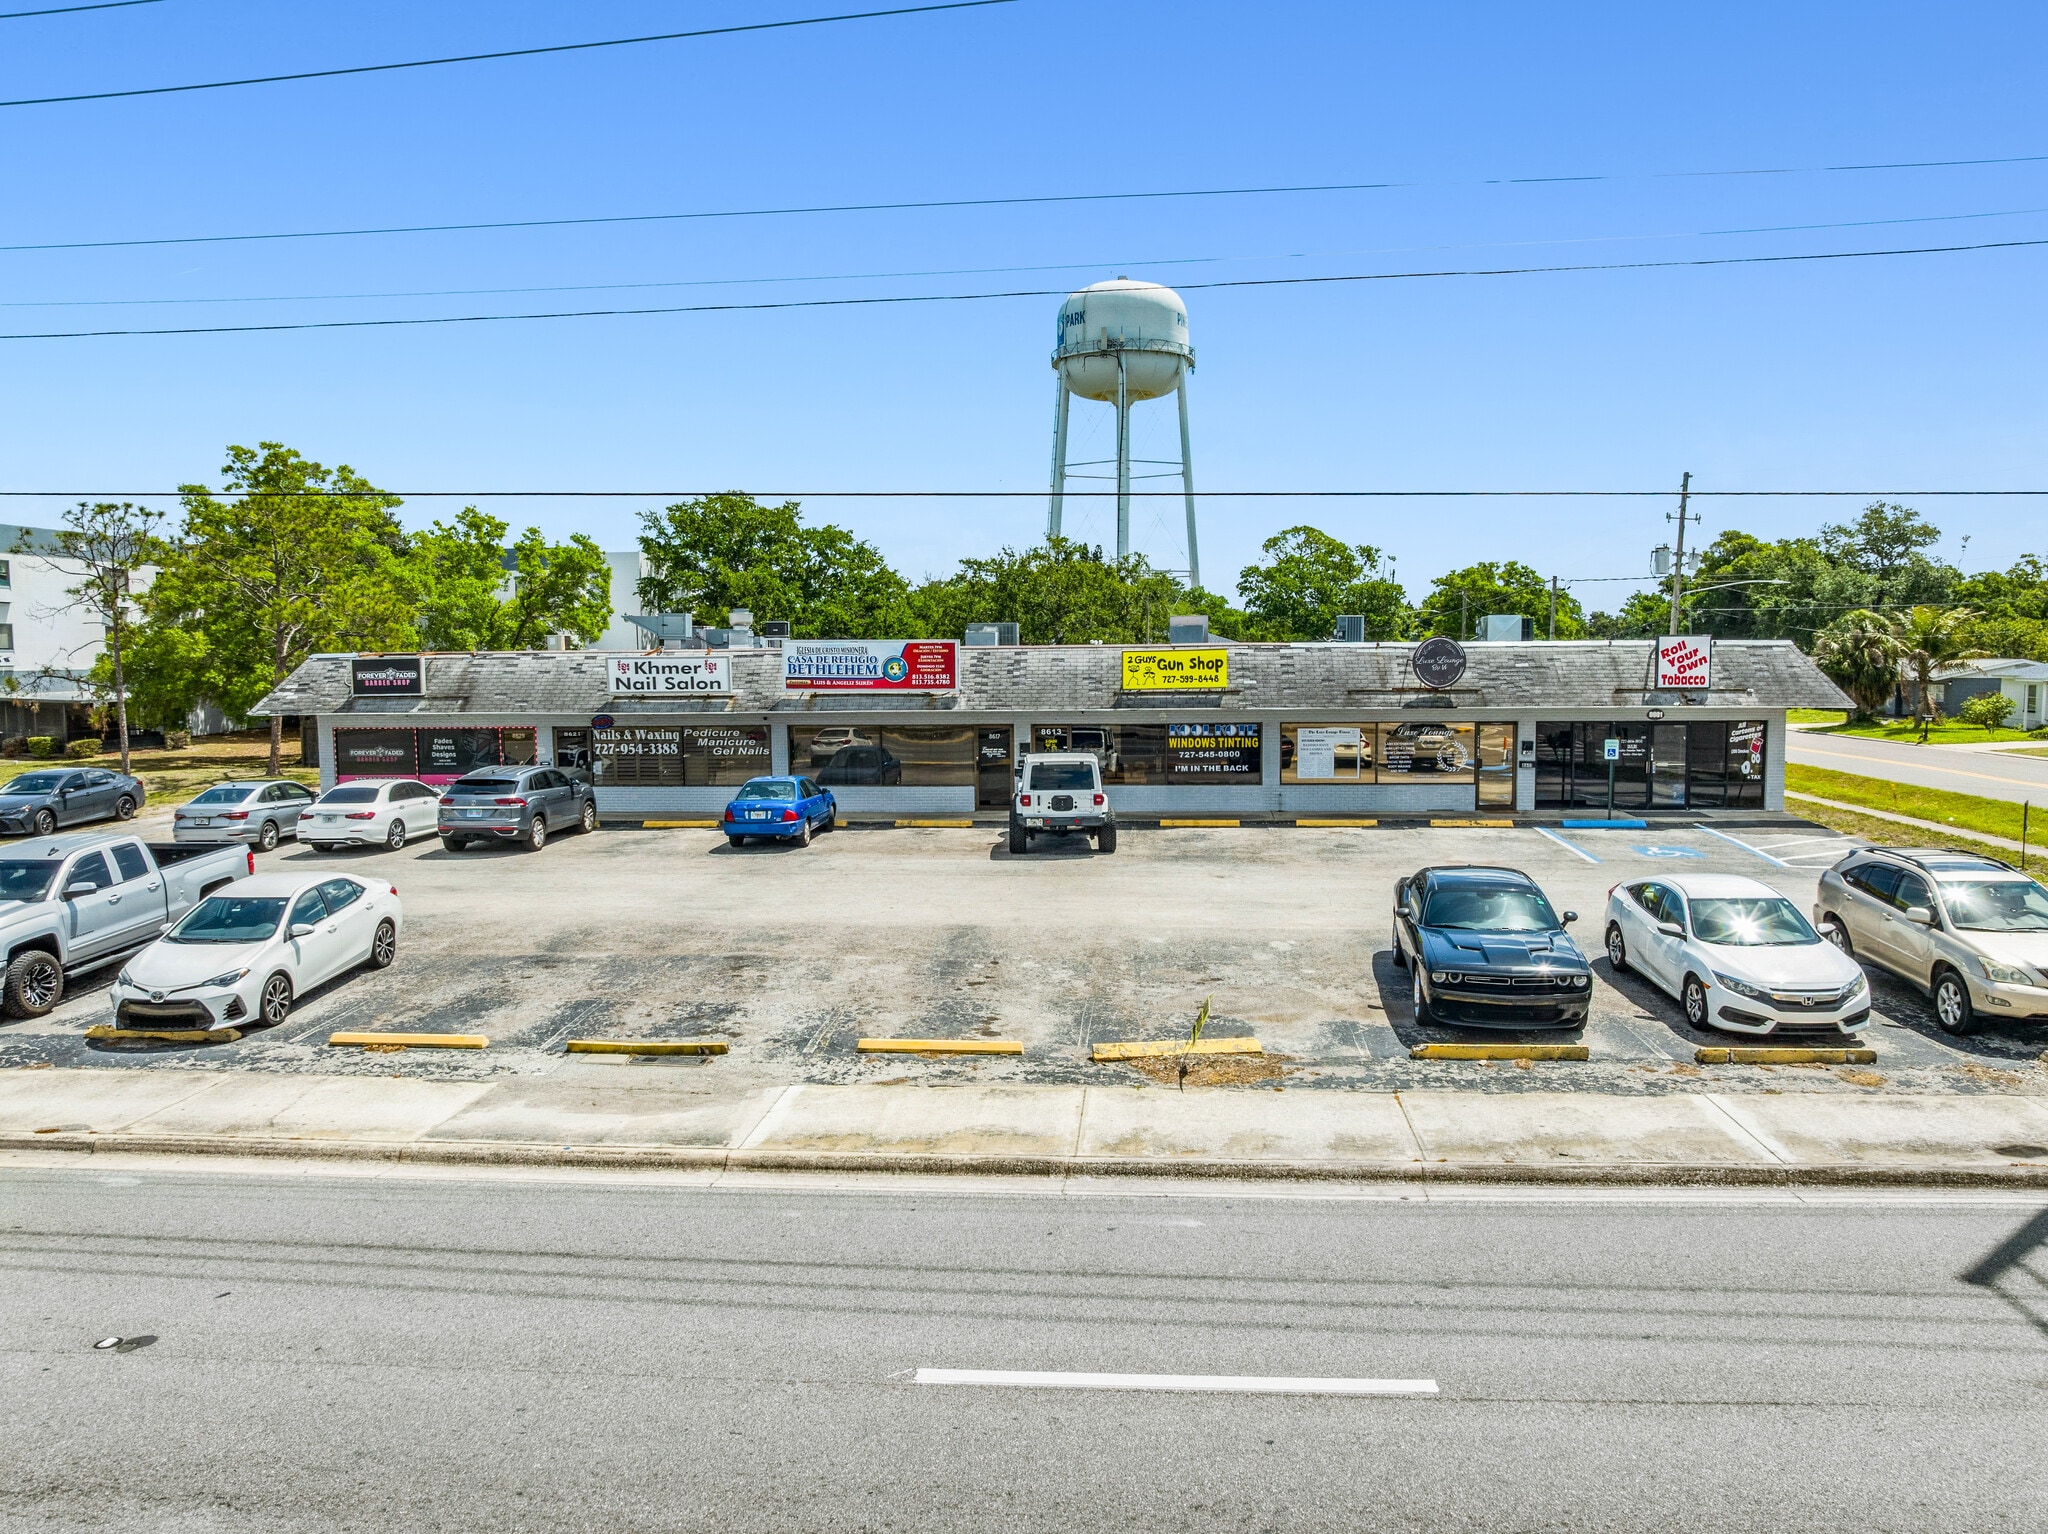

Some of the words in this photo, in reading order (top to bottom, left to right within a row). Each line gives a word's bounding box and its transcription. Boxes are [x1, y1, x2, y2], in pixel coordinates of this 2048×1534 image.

[1066, 310, 1086, 328] PARK
[1660, 640, 1687, 659] Roll
[787, 655, 815, 664] CASA
[816, 655, 830, 664] DE
[831, 655, 878, 664] REFUGIO
[1127, 656, 1133, 664] 2
[1134, 656, 1157, 664] GUYS
[1157, 658, 1184, 671] Gun
[1189, 656, 1224, 673] Shop
[1677, 656, 1708, 674] Own
[634, 661, 702, 674] Khmer
[787, 664, 878, 675] BETHLEHEM
[395, 671, 417, 679] FADED
[1162, 675, 1219, 683] 727-599-8448
[1661, 674, 1706, 685] Tobacco
[615, 676, 658, 690] Nail
[665, 676, 722, 690] Salon
[593, 729, 621, 740] Nails
[623, 730, 632, 740] &
[634, 729, 680, 742] Waxing
[683, 728, 740, 737] Pedicure
[1421, 726, 1455, 738] Lounge
[1731, 727, 1756, 736] Cartons
[697, 738, 757, 746] Manicure
[1168, 737, 1216, 748] WINDOWS
[1218, 737, 1259, 748] TINTING
[1729, 732, 1762, 743] Cigarettes
[594, 743, 679, 755] 727-954-3388
[713, 747, 735, 755] Gel
[738, 747, 771, 755] Nails
